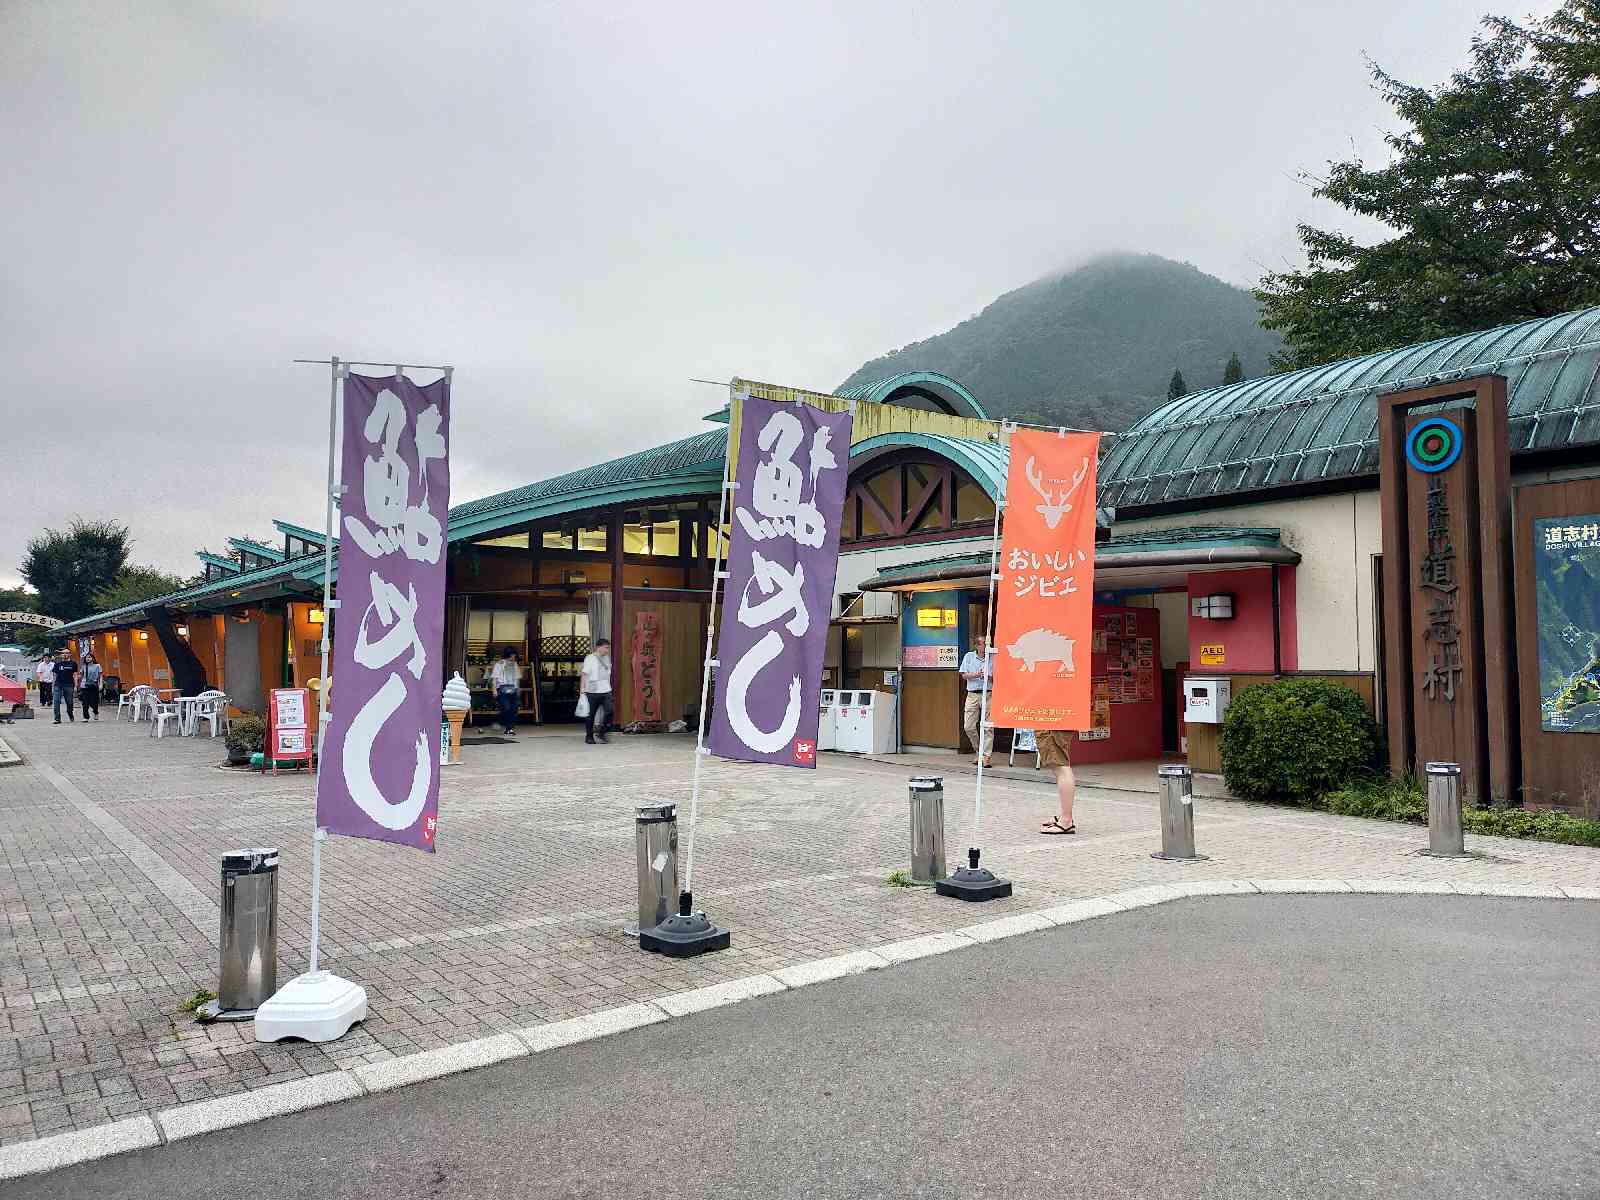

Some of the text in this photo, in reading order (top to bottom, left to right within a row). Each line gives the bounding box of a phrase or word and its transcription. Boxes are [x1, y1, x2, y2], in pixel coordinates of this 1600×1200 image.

[1544, 523, 1598, 544] 道志村
[1007, 547, 1088, 573] おいしい
[1013, 575, 1079, 598] ジビエ
[1201, 647, 1224, 656] AED
